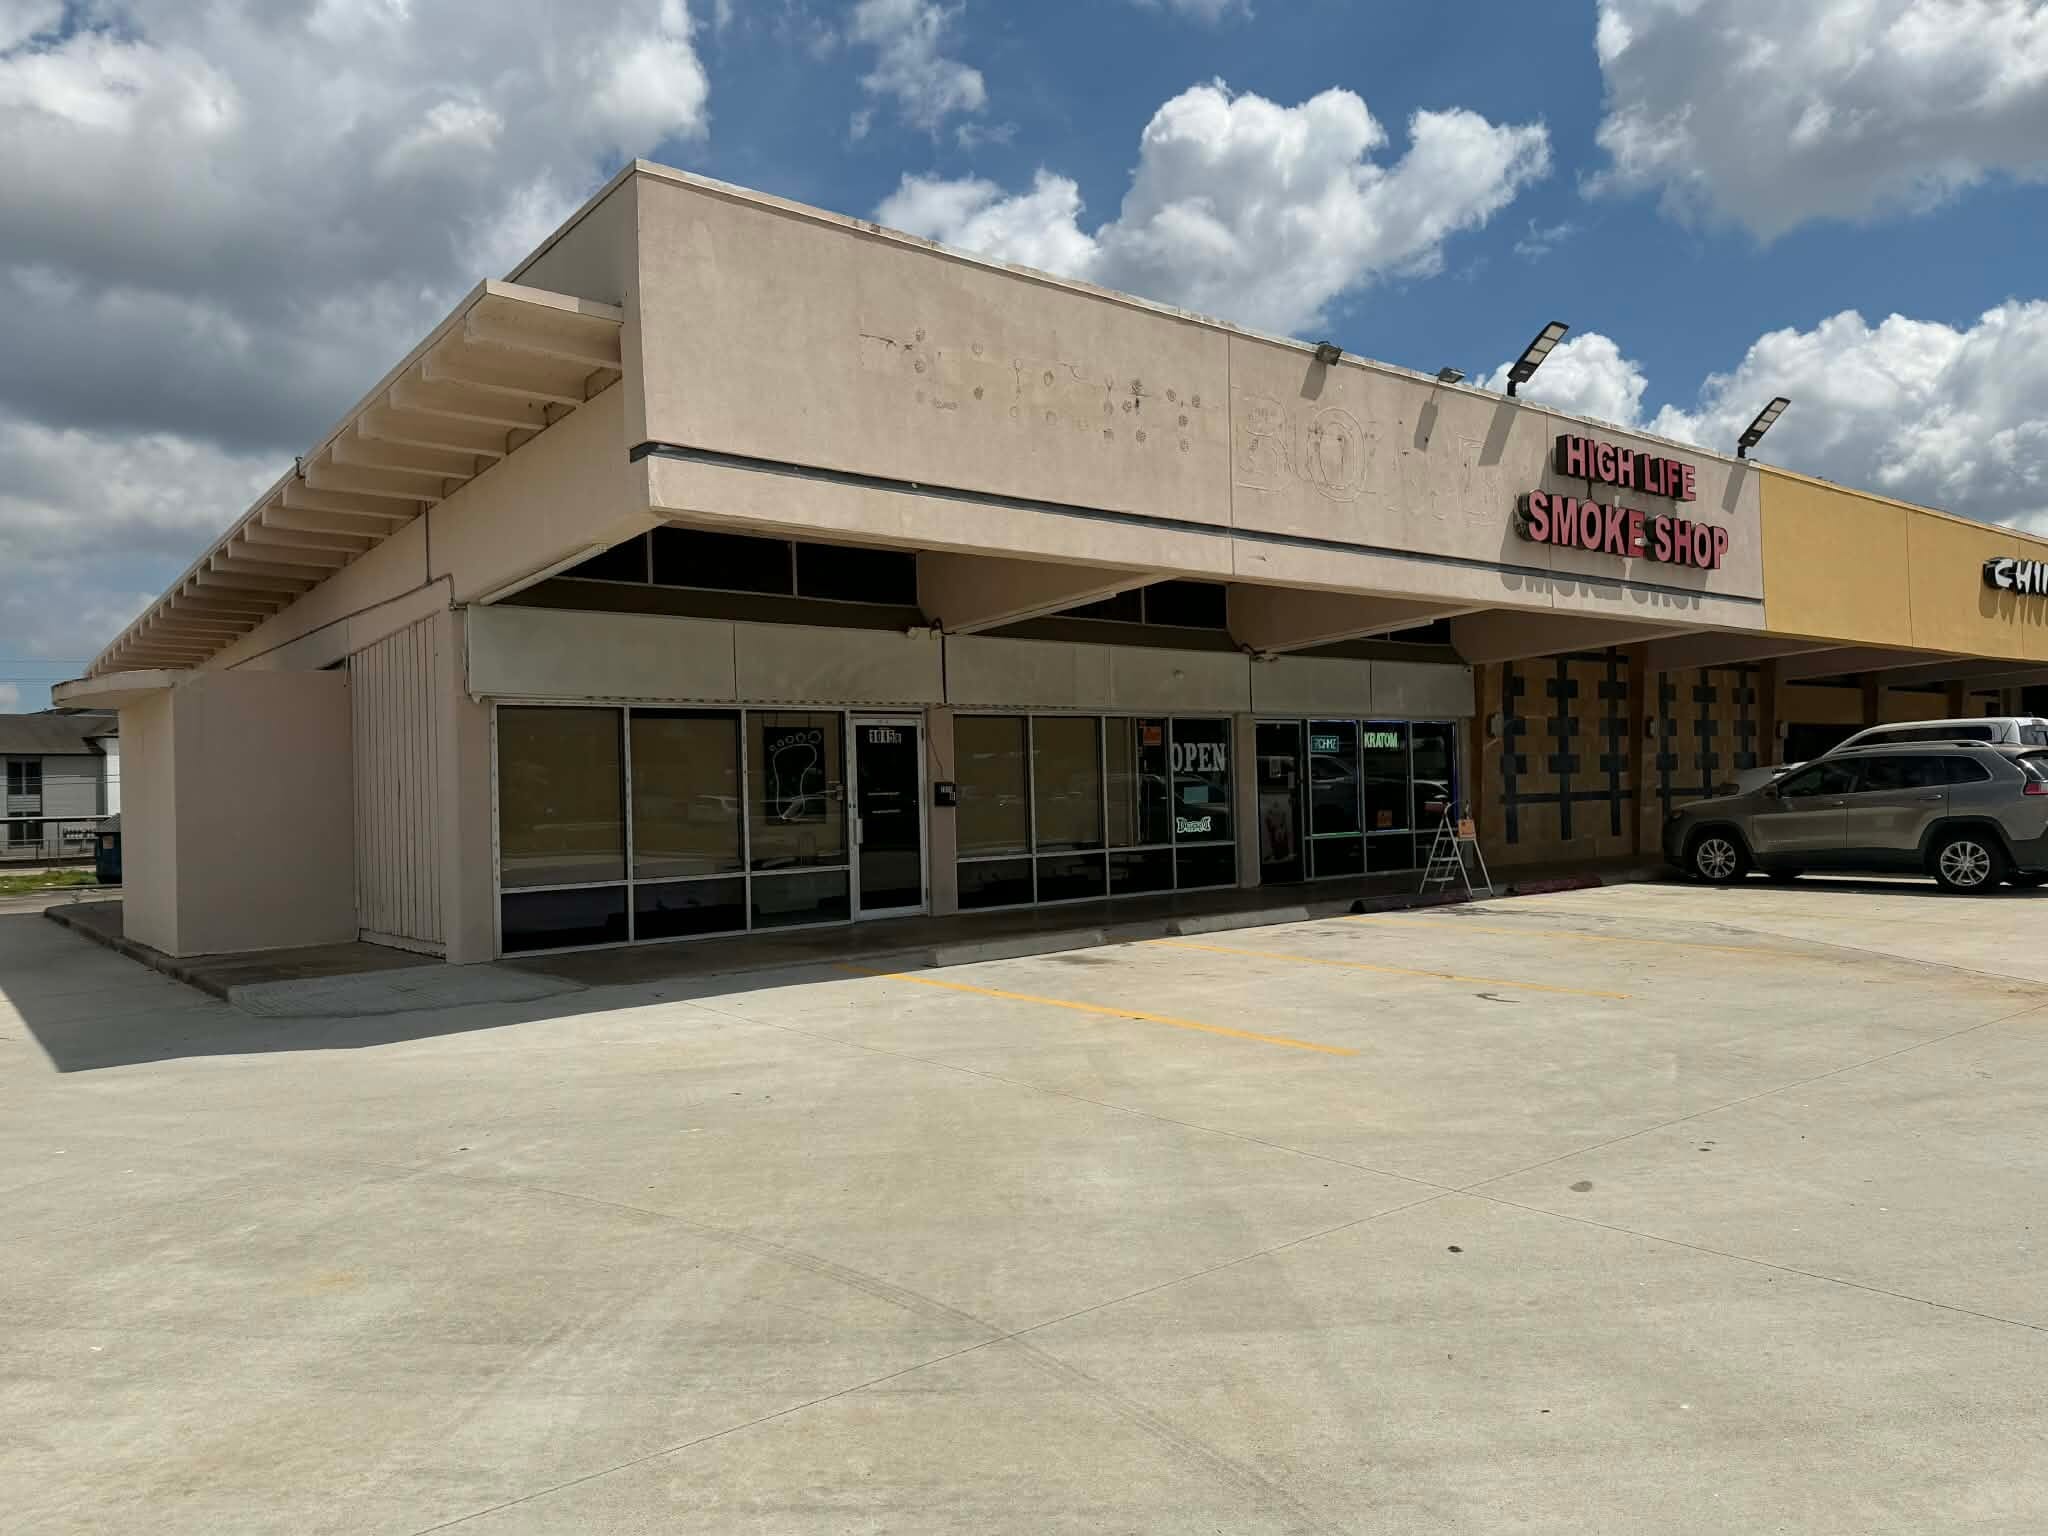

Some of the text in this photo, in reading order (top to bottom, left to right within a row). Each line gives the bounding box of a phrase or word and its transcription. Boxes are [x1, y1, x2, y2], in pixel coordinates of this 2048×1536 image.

[1564, 435, 1697, 502] HIGH LIFE
[1527, 488, 1729, 570] SMOKE SHOP
[1170, 742, 1226, 772] OPEN
[1364, 732, 1398, 748] KRATOM
